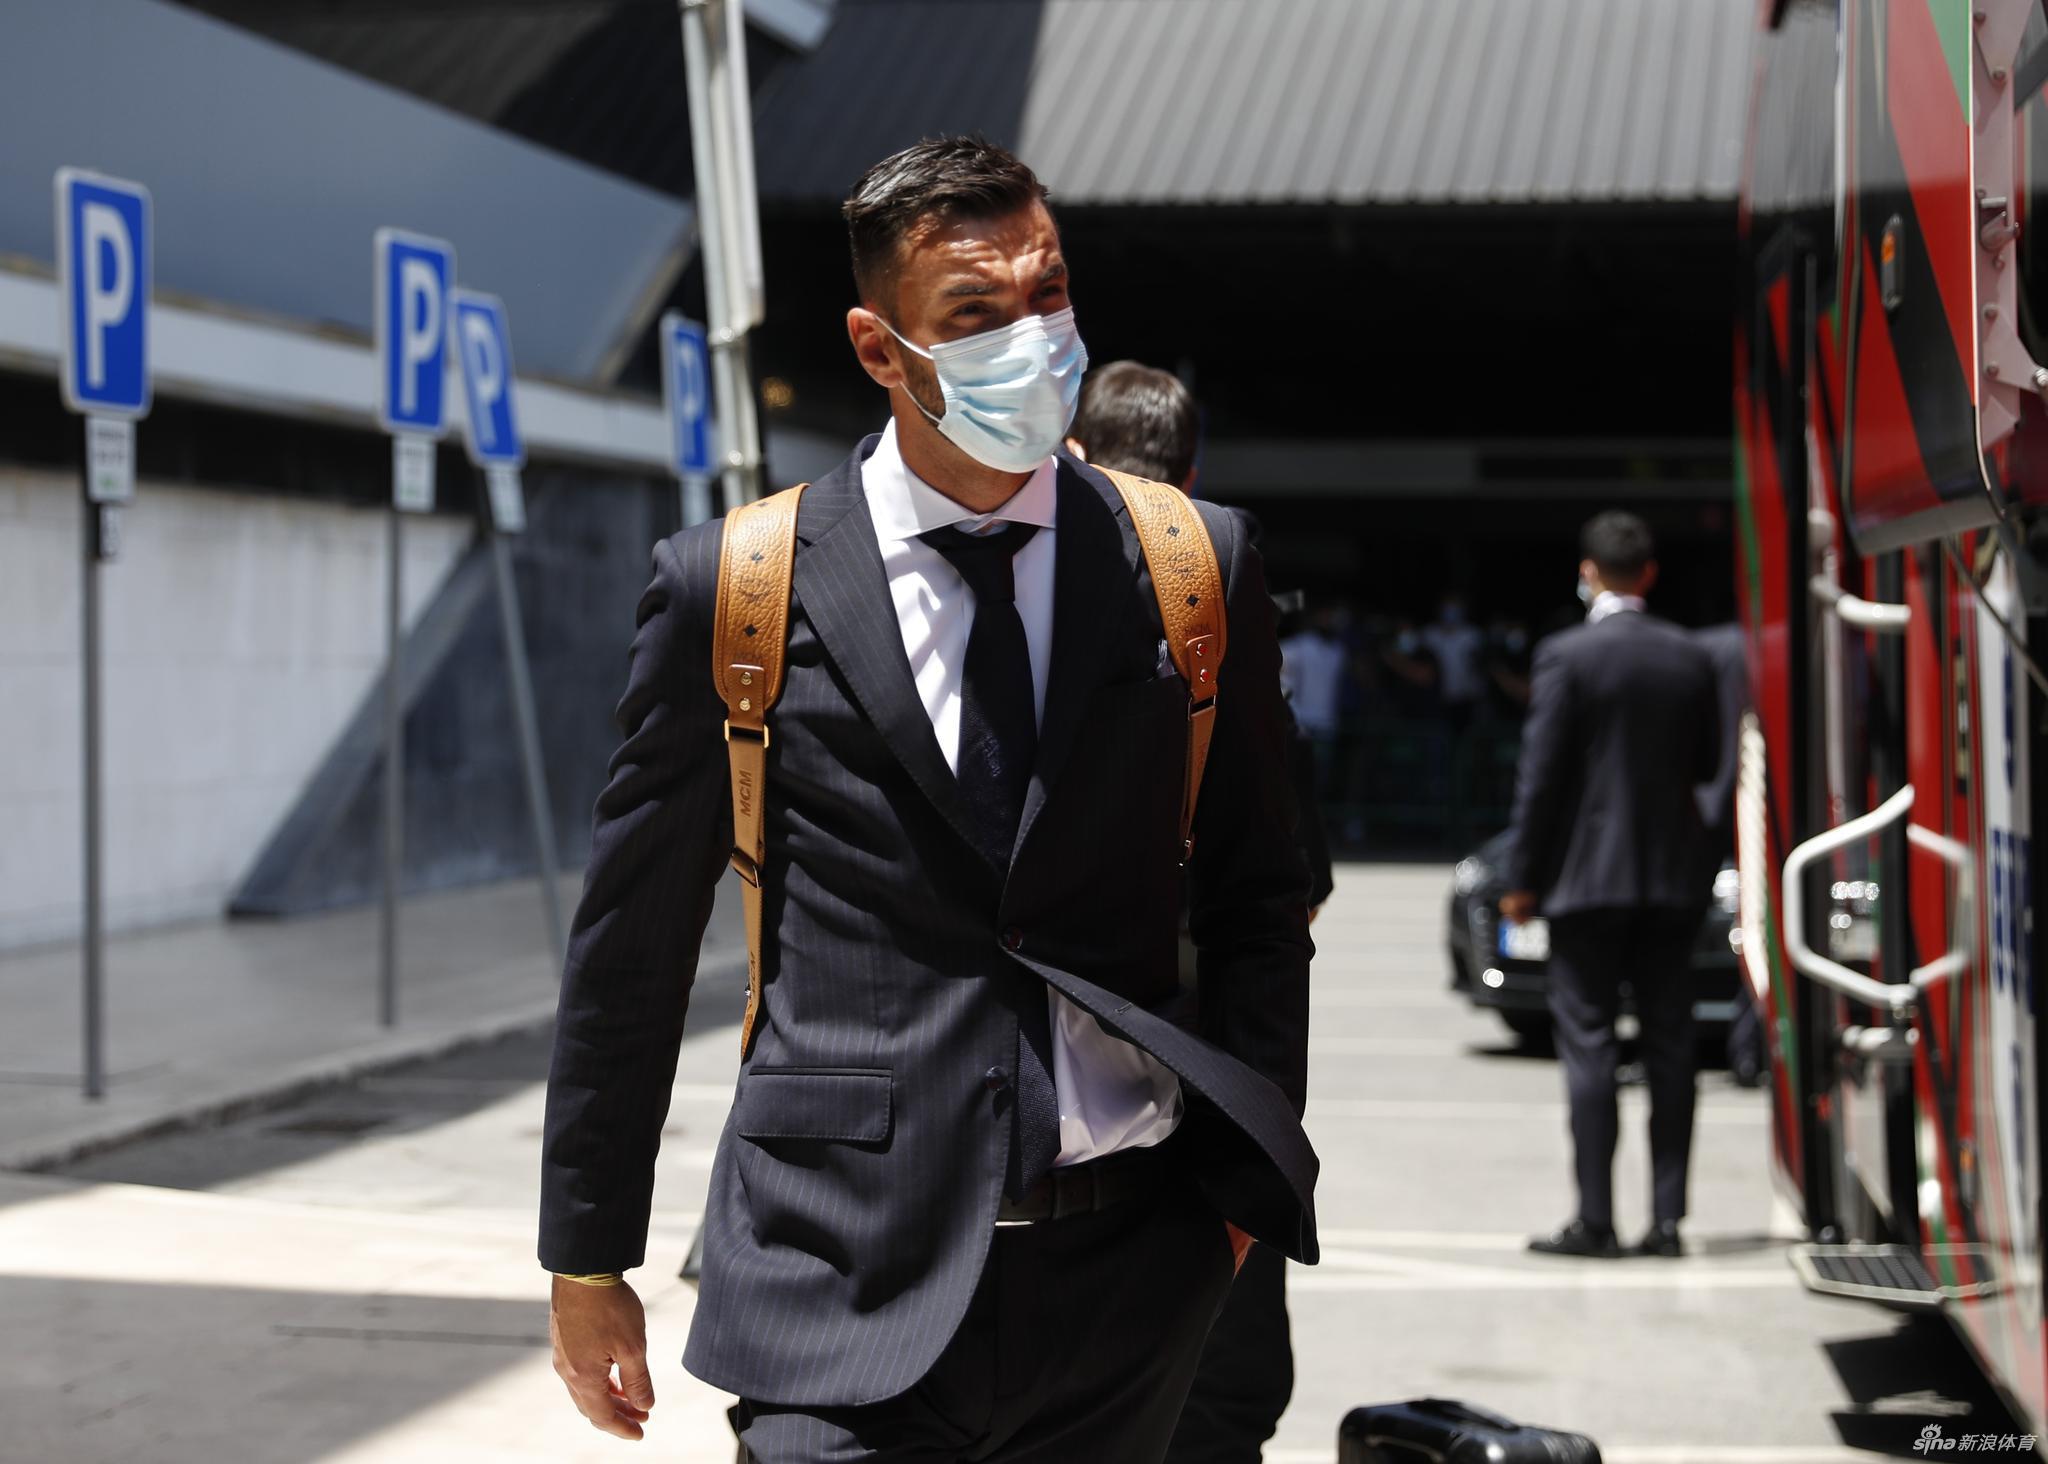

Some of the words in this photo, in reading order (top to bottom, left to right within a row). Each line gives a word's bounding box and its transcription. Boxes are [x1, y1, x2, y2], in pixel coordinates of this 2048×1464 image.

[82, 201, 135, 389] P
[400, 257, 443, 417] P
[463, 310, 503, 449] P
[678, 342, 707, 464] P
[739, 769, 752, 817] MCM
